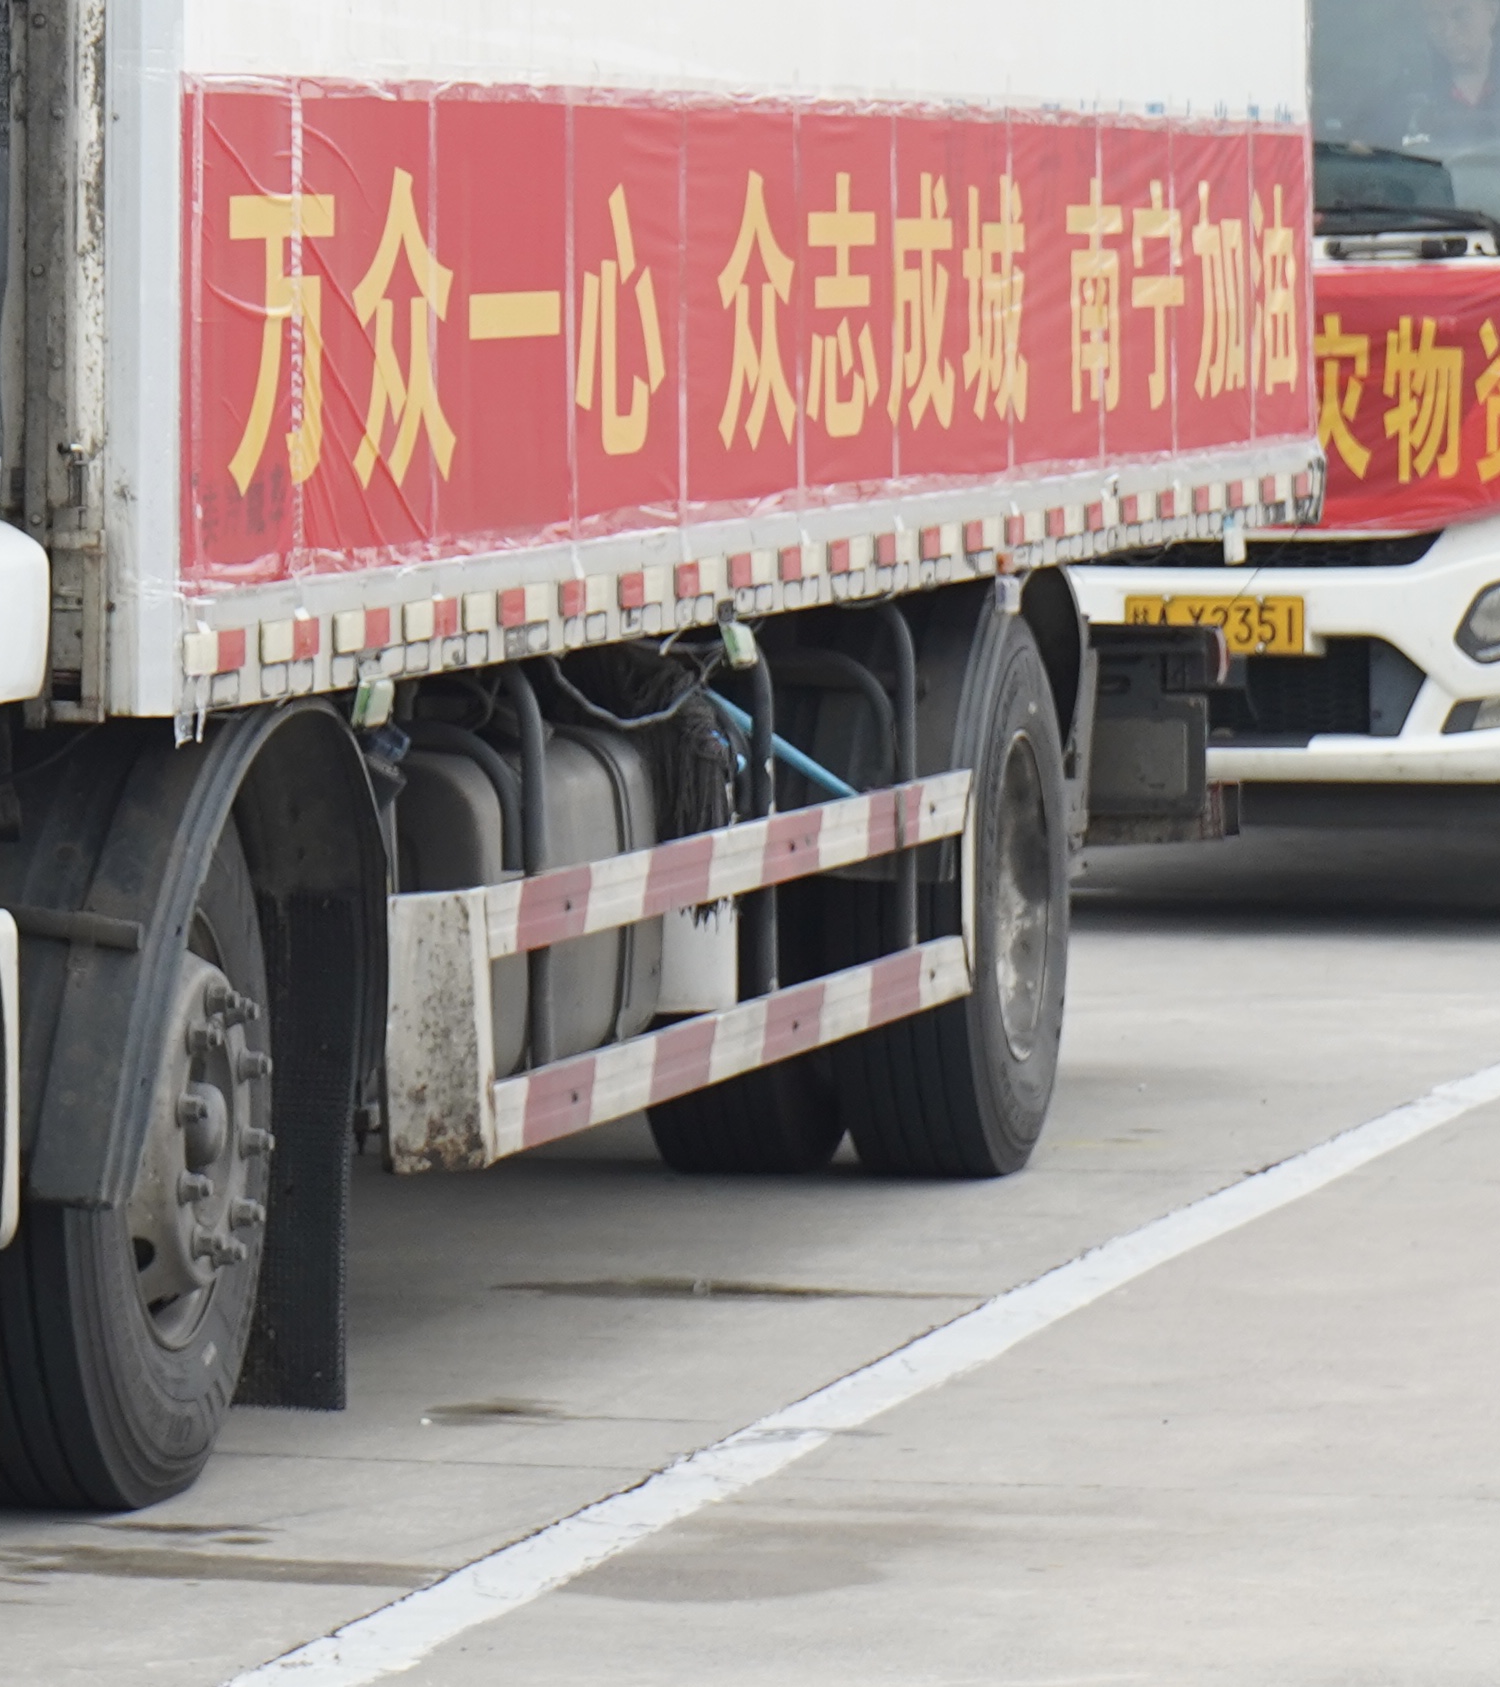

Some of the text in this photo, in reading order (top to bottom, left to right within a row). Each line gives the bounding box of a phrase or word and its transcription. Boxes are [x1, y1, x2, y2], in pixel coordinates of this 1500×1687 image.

[228, 166, 1299, 497] 万众一心 众志成城 南宁加油
